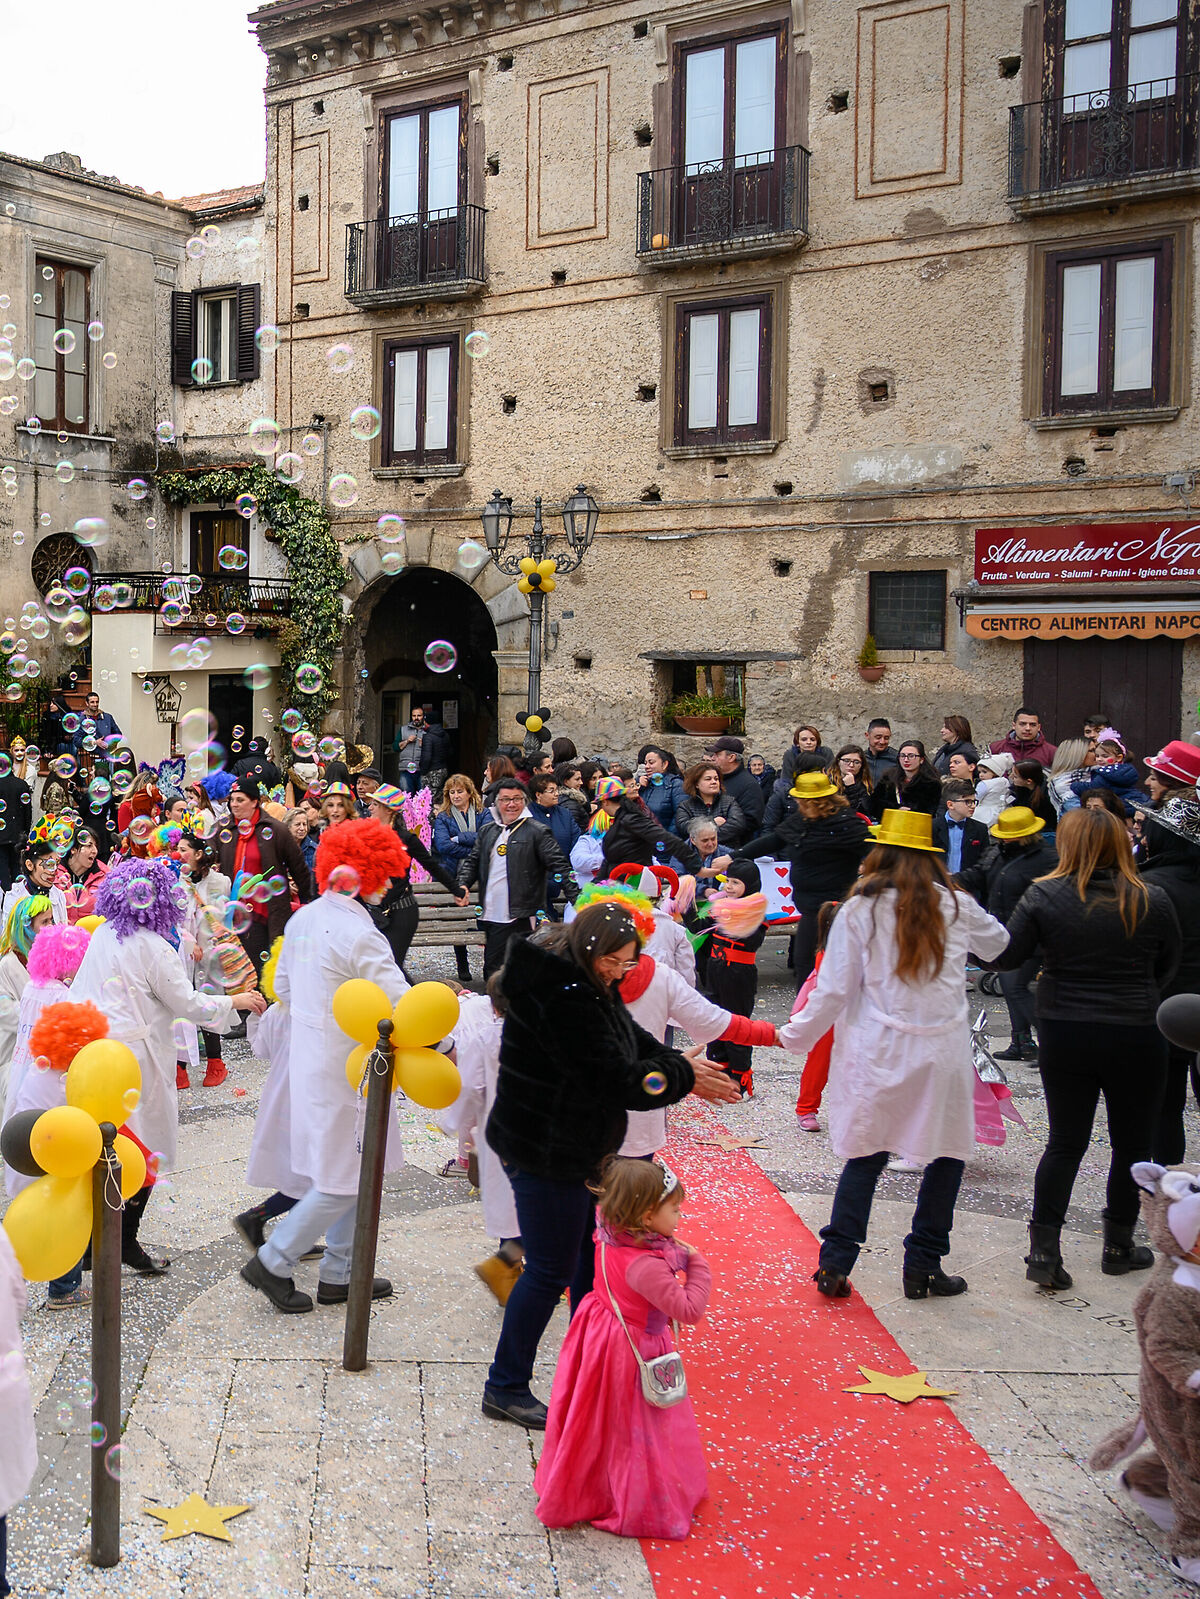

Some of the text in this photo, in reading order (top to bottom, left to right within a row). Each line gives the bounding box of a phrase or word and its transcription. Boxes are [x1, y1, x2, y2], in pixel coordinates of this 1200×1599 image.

[981, 538, 1119, 564] Alimentari
[981, 571, 1008, 580] Frutta
[1015, 570, 1050, 580] Verdura
[1060, 569, 1093, 578] Salumi
[1100, 568, 1131, 578] Panini
[1138, 567, 1168, 579] Igiene
[1170, 567, 1195, 576] Casa
[981, 617, 1041, 631] CENTRO
[1049, 615, 1146, 631] ALIMENTARI
